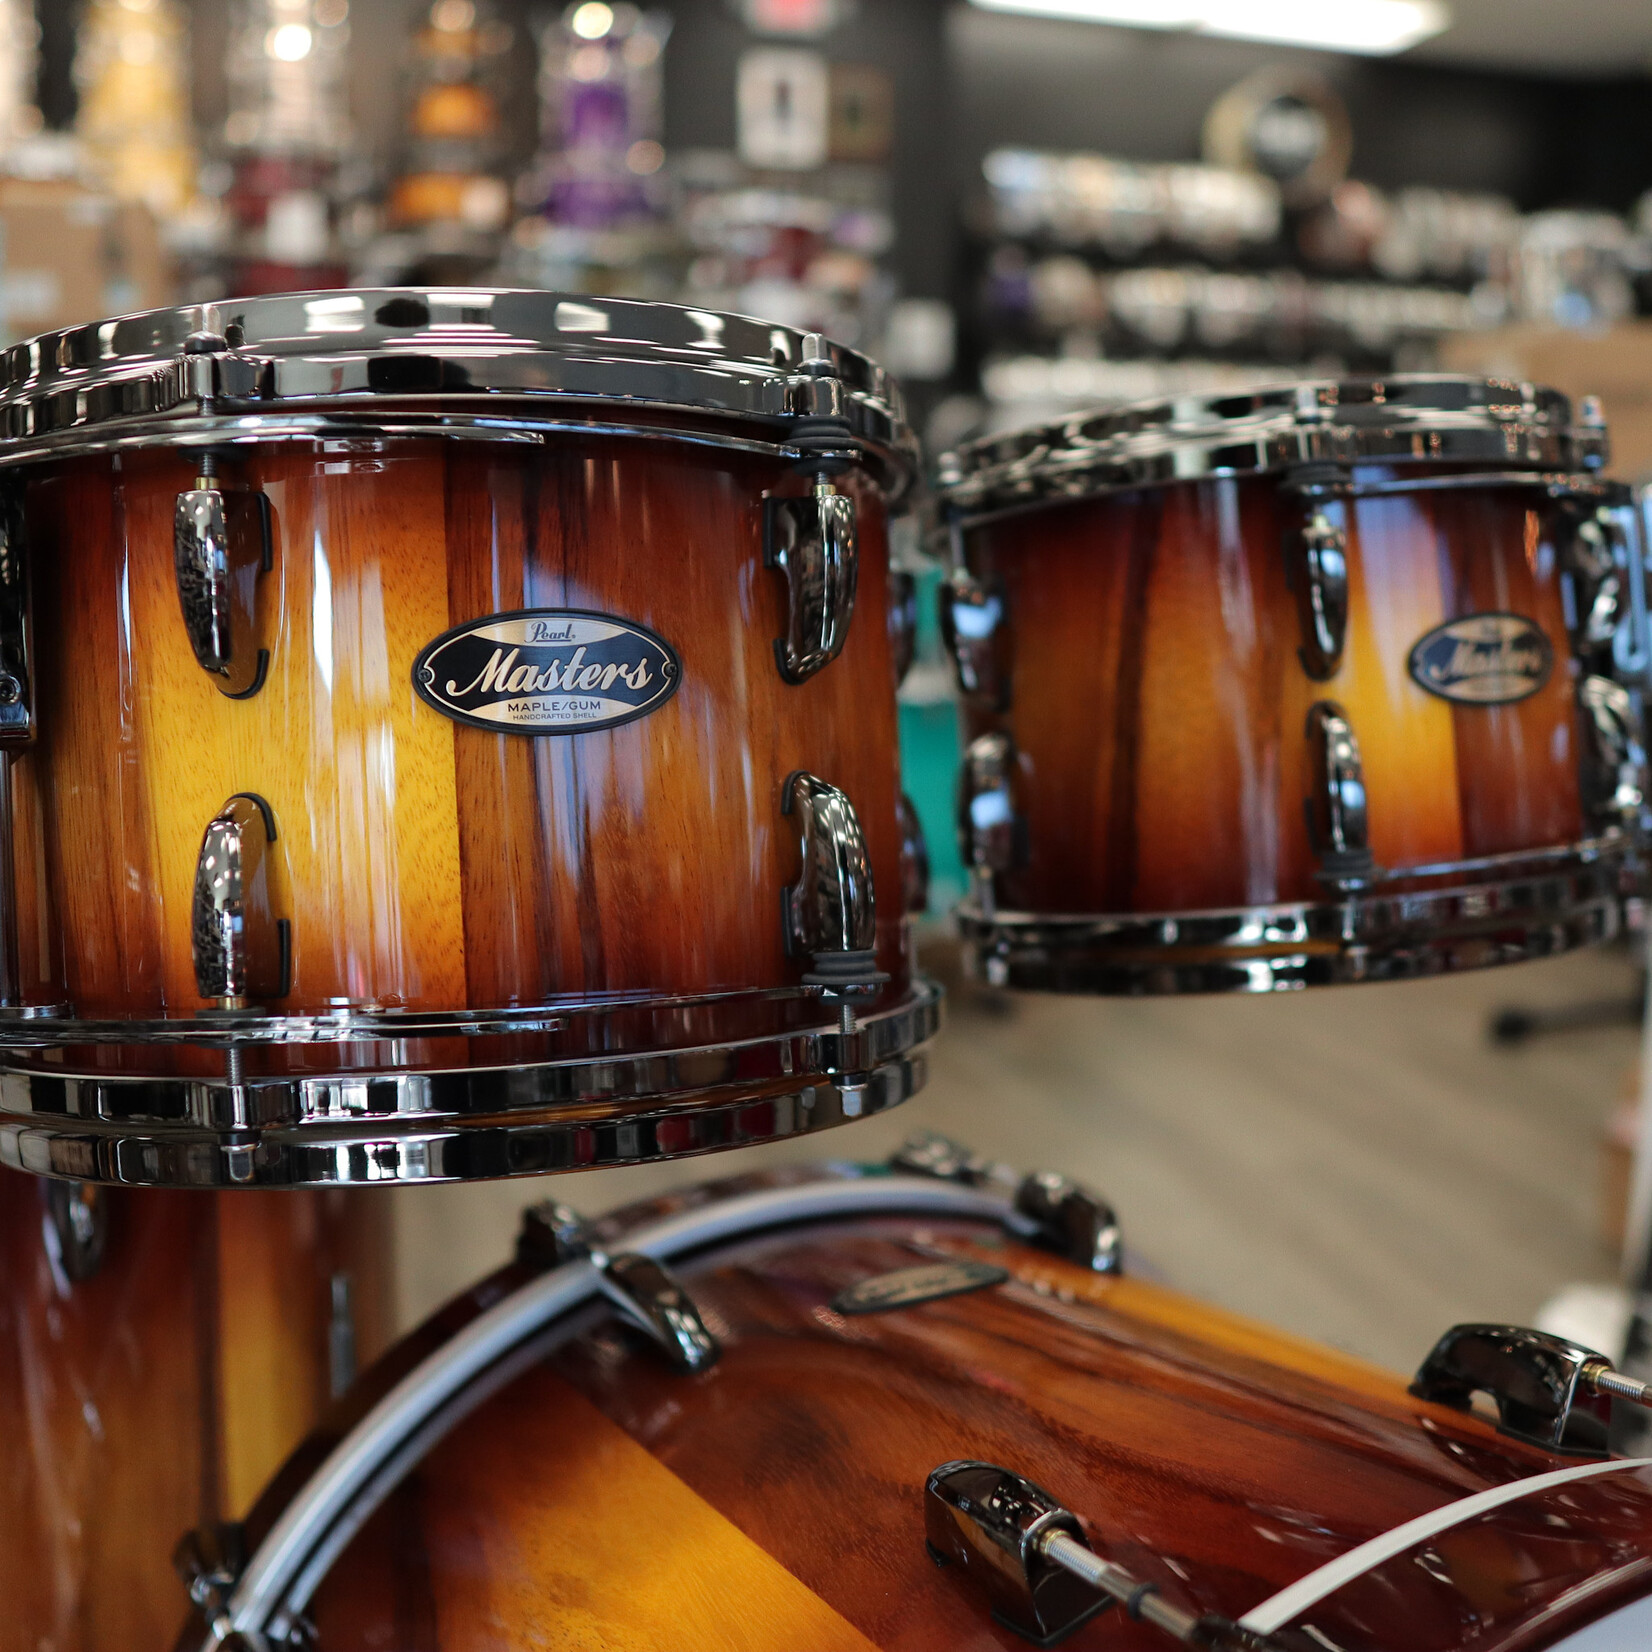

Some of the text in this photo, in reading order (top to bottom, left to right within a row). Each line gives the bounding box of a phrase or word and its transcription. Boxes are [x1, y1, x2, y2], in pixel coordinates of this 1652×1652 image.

[524, 621, 573, 643] Pearl
[446, 647, 653, 697] Masters
[507, 700, 602, 713] MAPLE/GUM
[512, 712, 597, 721] HANDCRAFTED SHELL
